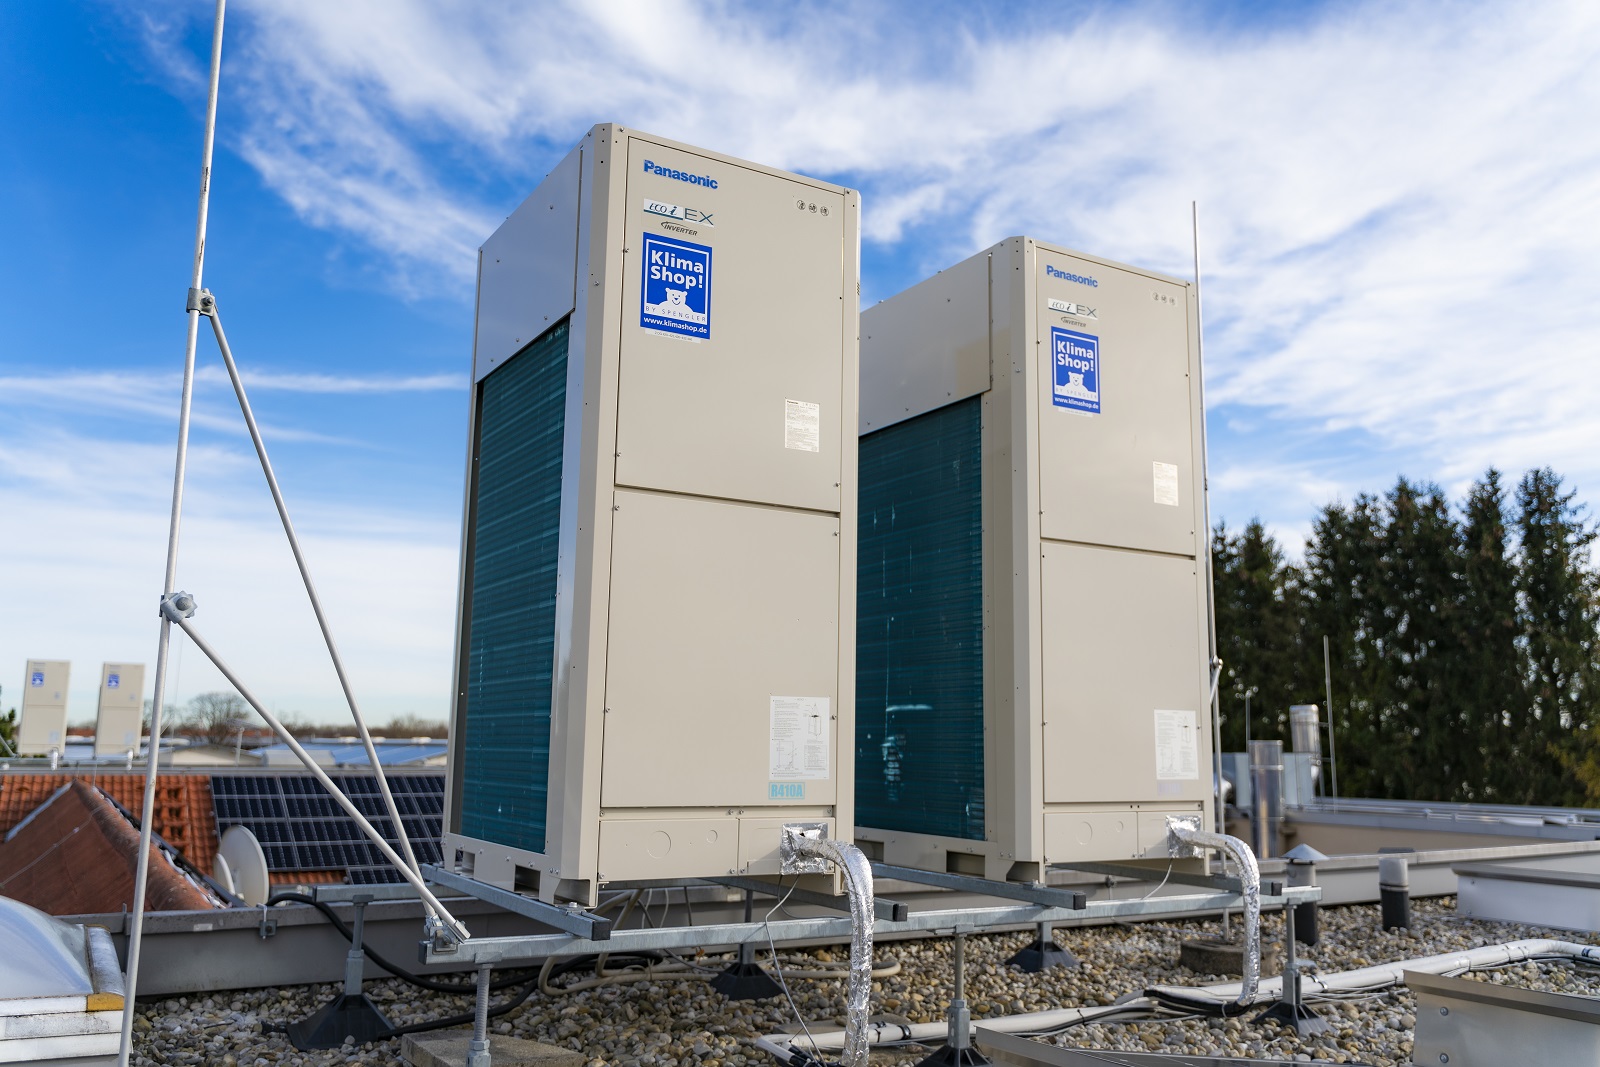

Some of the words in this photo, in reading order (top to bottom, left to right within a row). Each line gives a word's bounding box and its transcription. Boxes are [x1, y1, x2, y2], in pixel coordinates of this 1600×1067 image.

[643, 159, 719, 190] Panasonic
[684, 207, 714, 226] EX
[663, 224, 698, 236] INVERTER
[650, 249, 704, 274] Klima
[650, 265, 703, 289] Shop!
[1046, 264, 1099, 288] Panasonic
[645, 305, 657, 313] BY
[661, 308, 706, 322] SPENGLER
[1076, 304, 1097, 318] EX
[643, 316, 708, 333] www.klimashop.de
[1062, 319, 1087, 328] INVERTER
[1057, 340, 1094, 359] Klima
[1057, 353, 1094, 373] Shop!
[1054, 397, 1099, 410] www.klimashop.de
[770, 784, 803, 797] R410A
